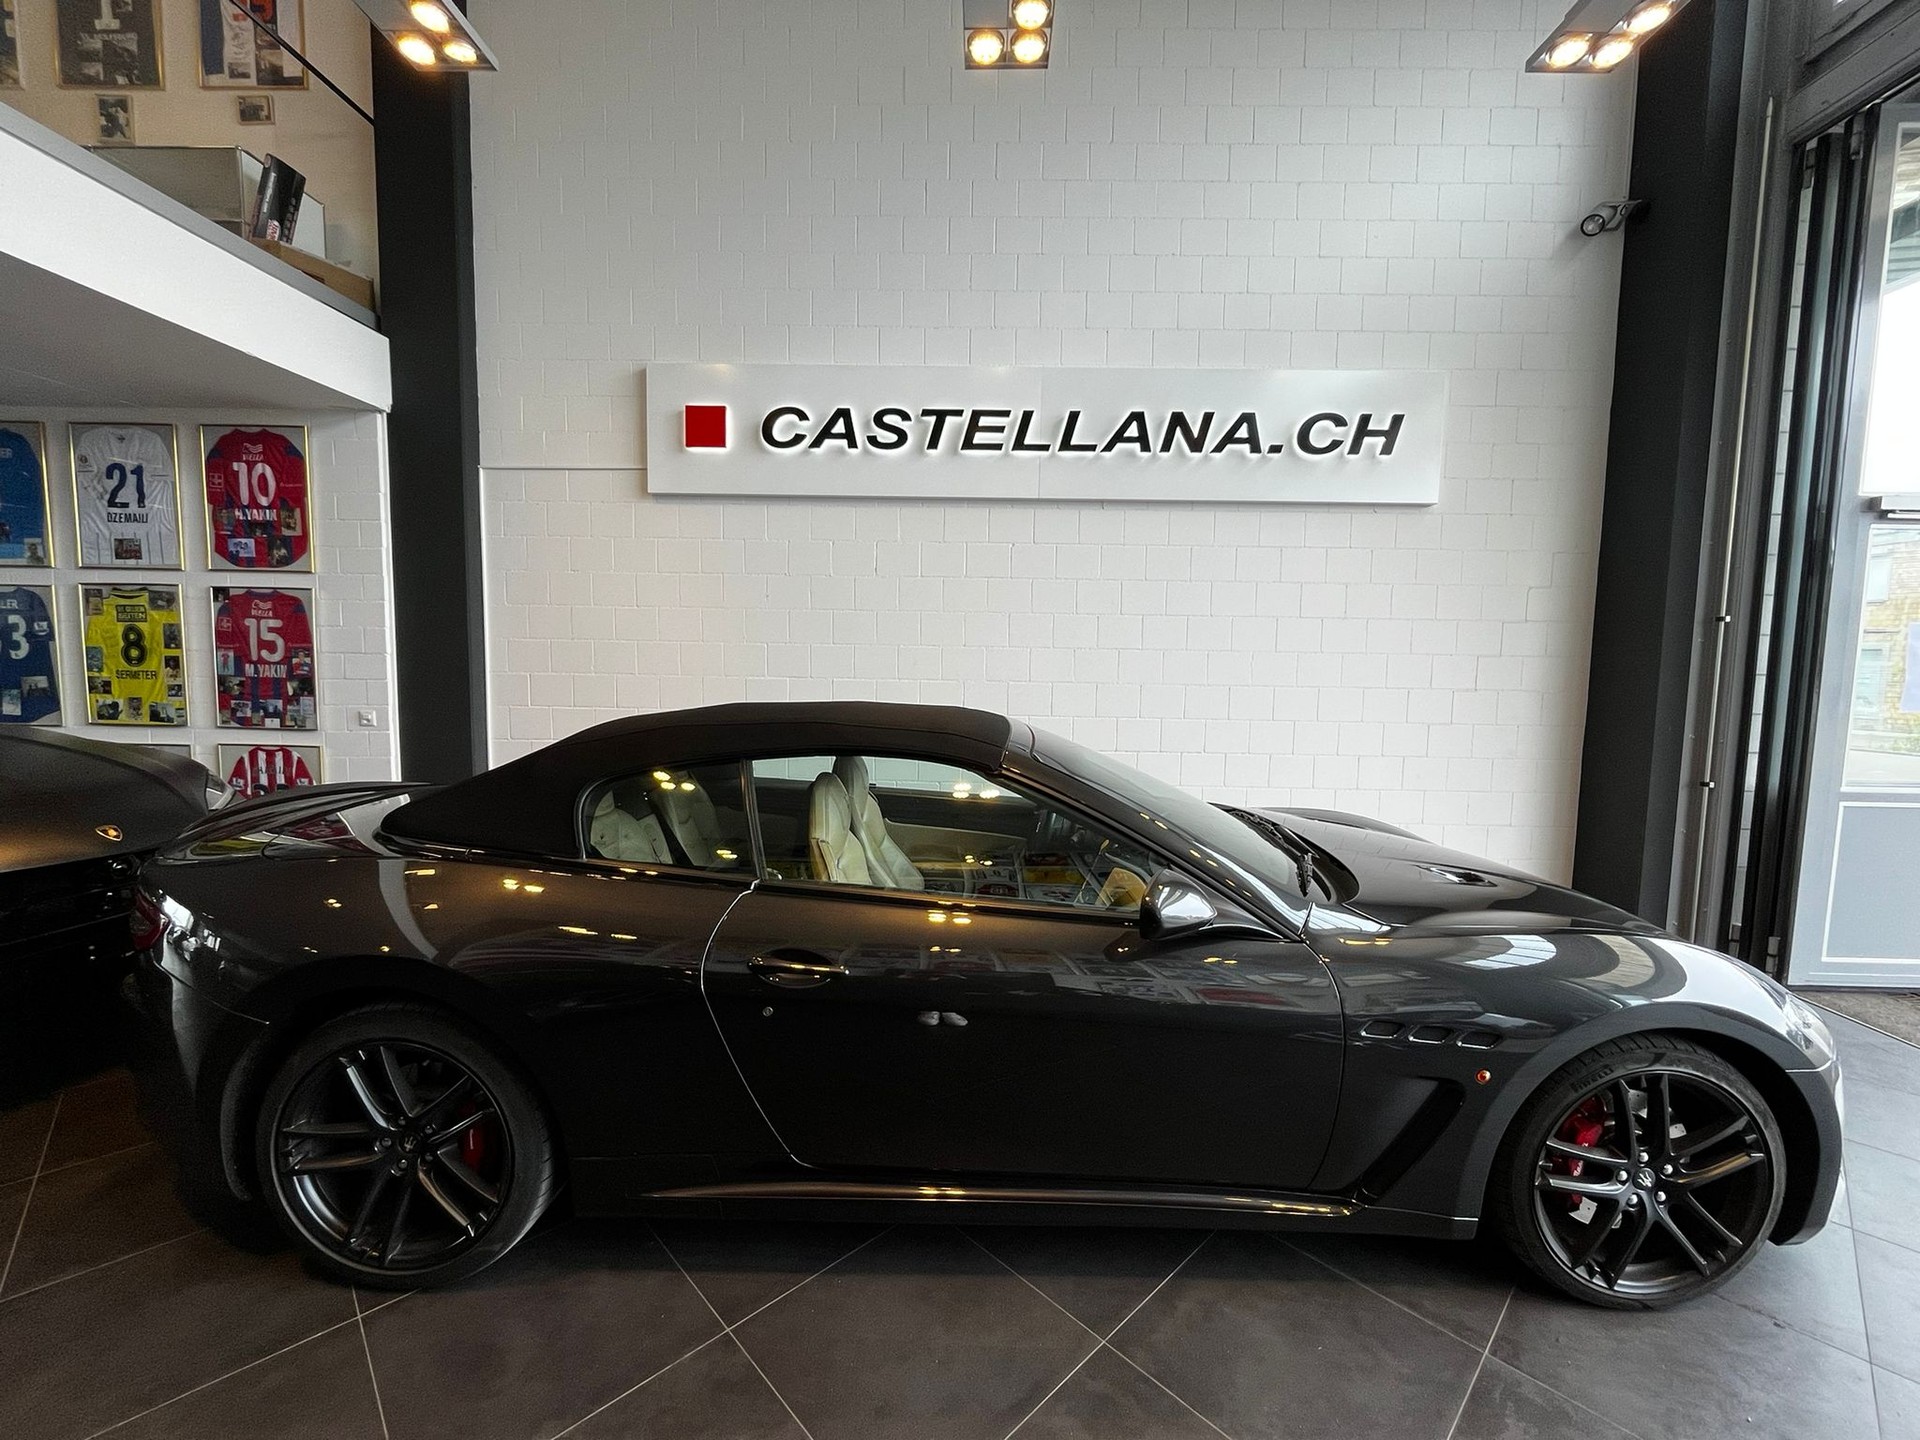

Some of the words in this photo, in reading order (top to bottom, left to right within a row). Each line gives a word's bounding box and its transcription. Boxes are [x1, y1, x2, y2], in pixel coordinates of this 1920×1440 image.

[760, 407, 1405, 457] CASTELLANA.CH
[105, 462, 146, 508] 21
[232, 462, 277, 506] 10
[0, 614, 30, 660] 3
[120, 623, 148, 667] 8
[244, 617, 286, 662] 15
